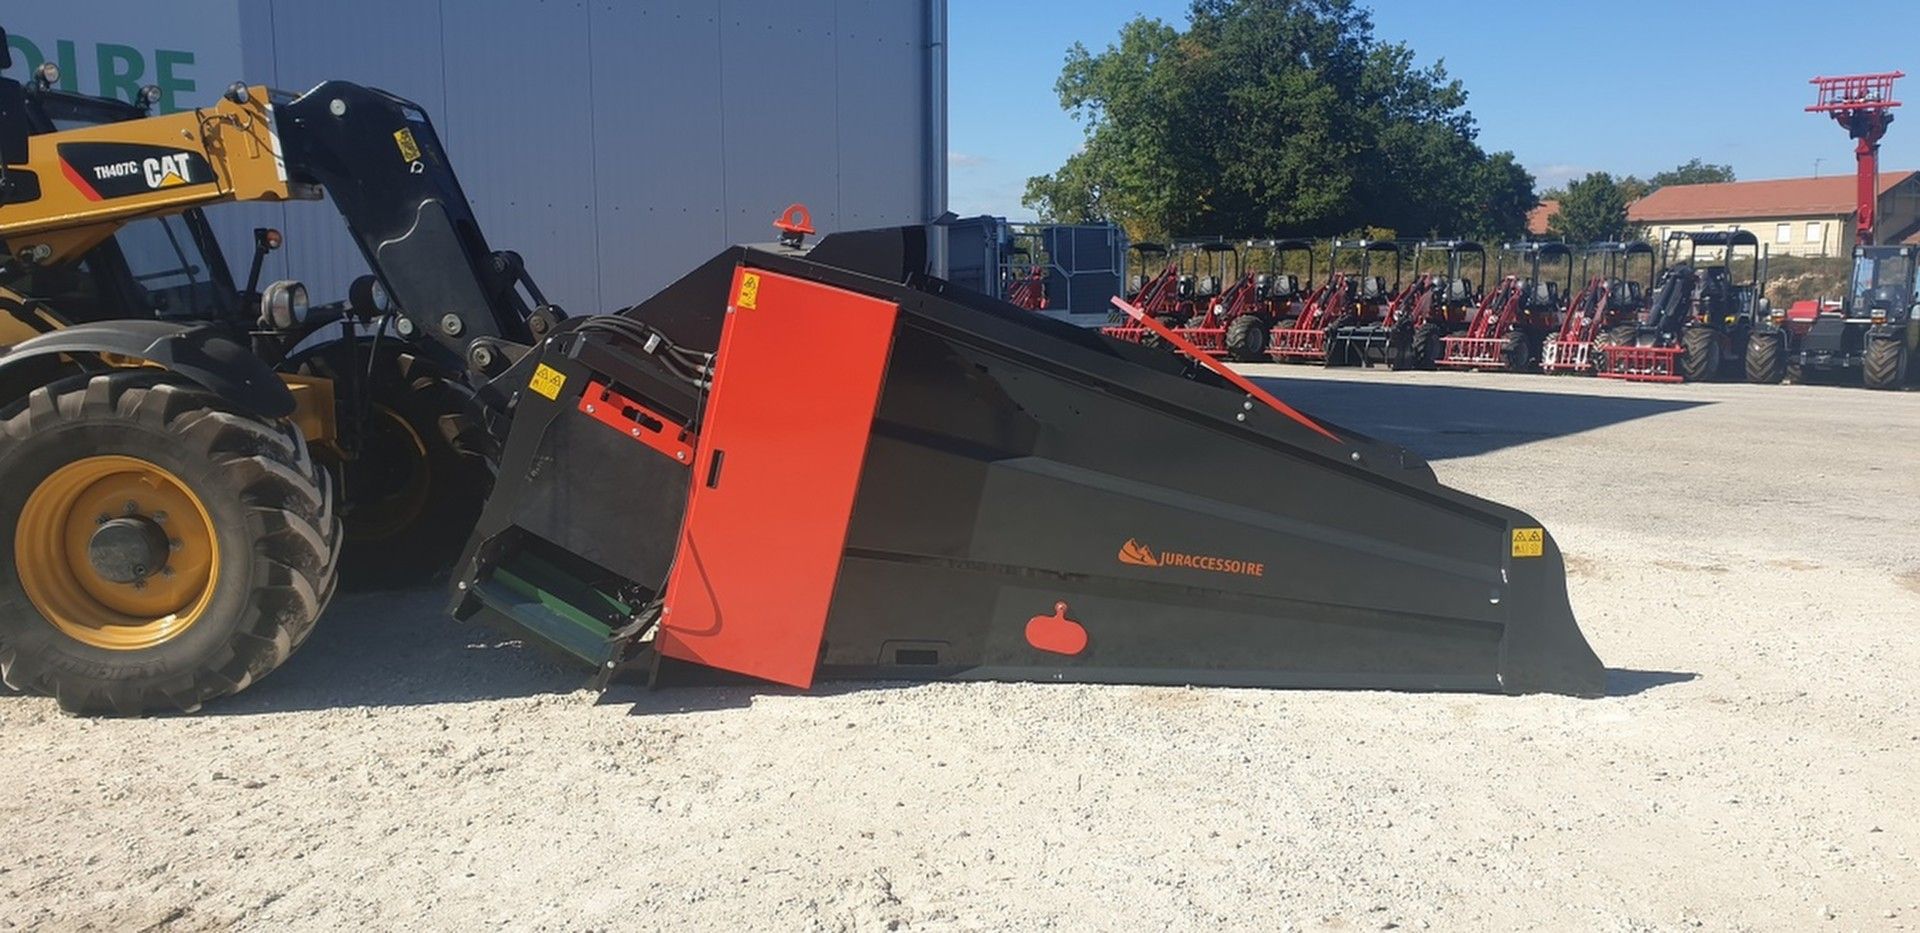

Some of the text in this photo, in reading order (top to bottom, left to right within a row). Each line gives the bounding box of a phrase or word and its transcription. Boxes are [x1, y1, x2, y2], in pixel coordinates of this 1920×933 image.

[93, 152, 191, 188] TH407C CAT
[1159, 551, 1264, 577] JURACCESSOIRE
